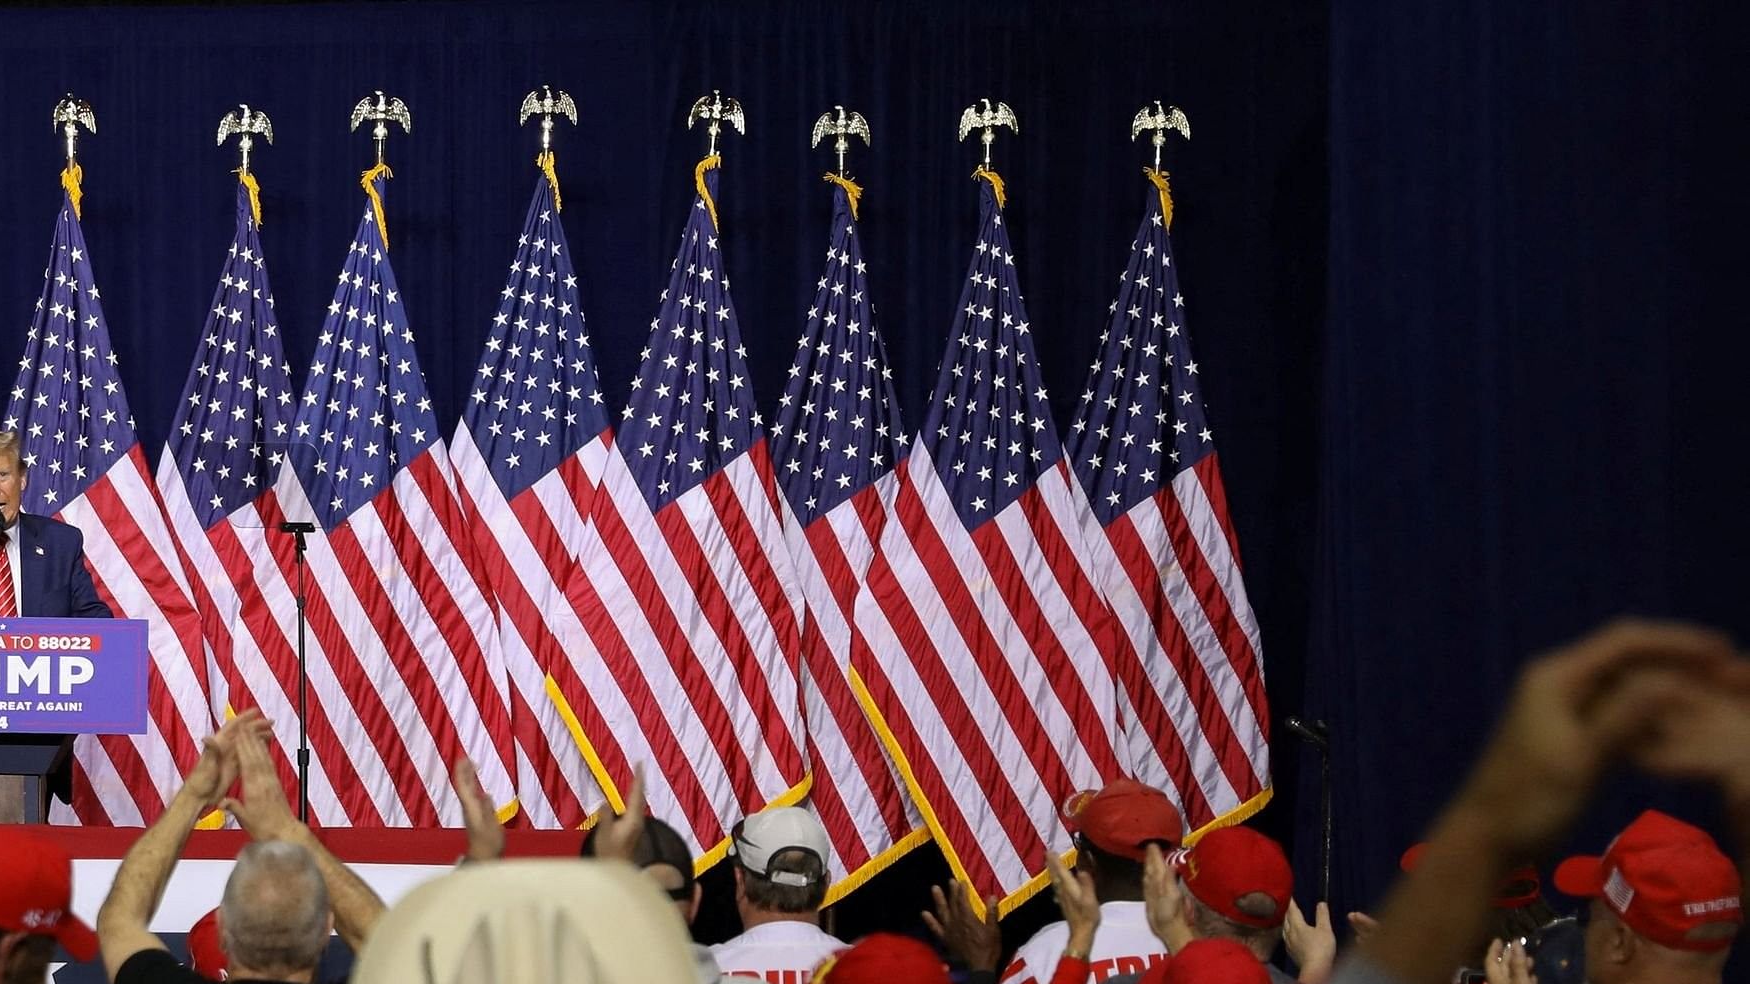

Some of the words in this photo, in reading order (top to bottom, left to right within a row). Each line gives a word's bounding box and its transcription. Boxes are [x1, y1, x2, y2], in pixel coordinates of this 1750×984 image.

[10, 636, 34, 649] TO
[38, 636, 91, 650] 88022
[36, 702, 83, 712] AGAIN!
